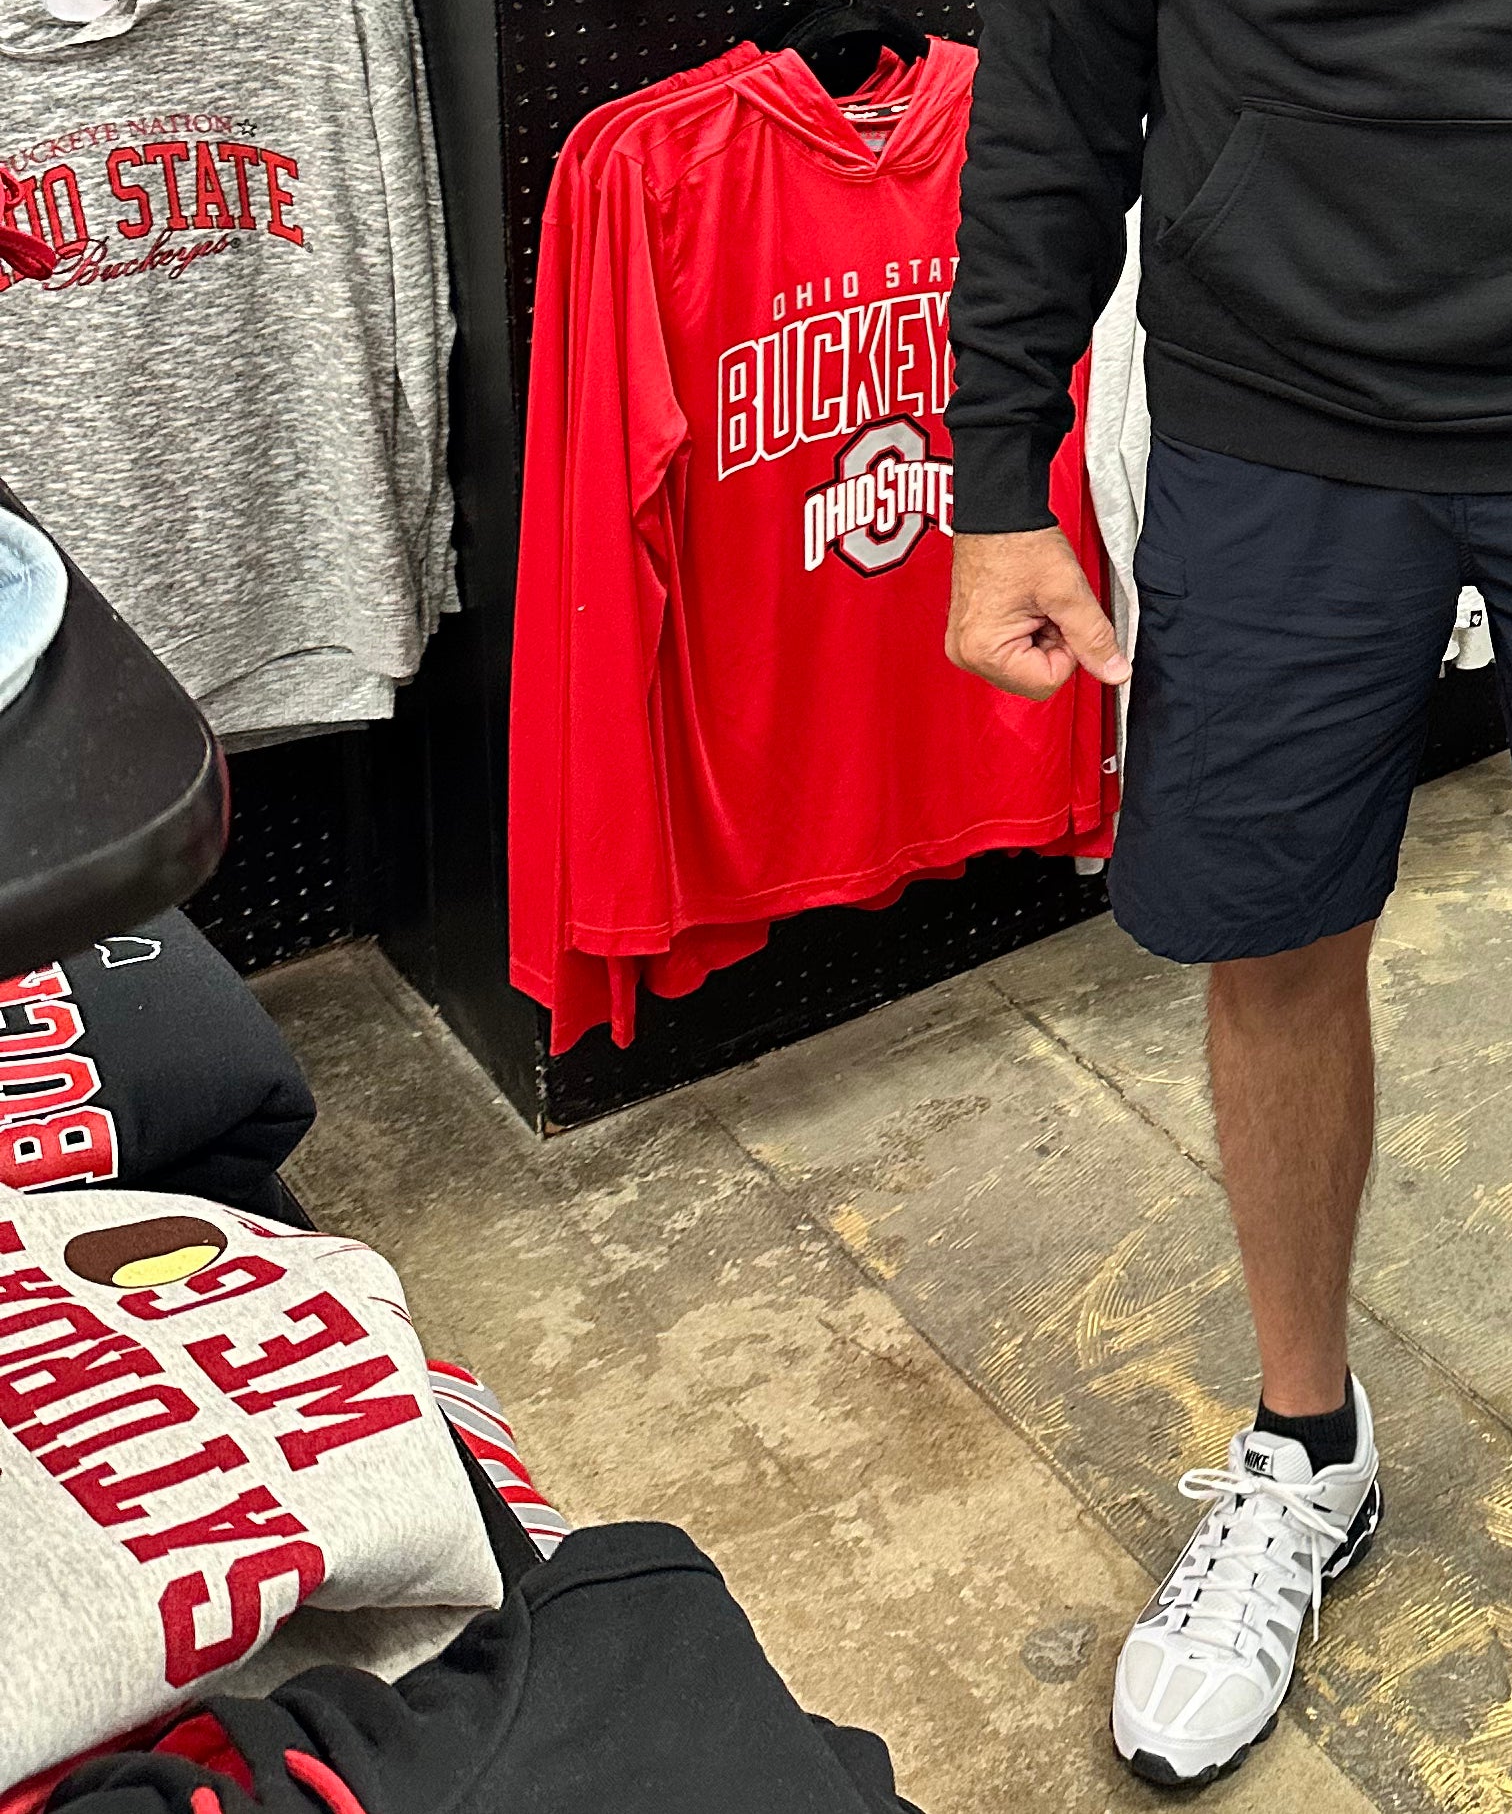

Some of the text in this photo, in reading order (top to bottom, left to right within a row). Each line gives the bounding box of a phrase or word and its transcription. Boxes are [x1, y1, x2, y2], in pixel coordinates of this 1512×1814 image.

[126, 114, 234, 137] NATION
[106, 141, 304, 248] STATE
[43, 227, 230, 291] Buckeyes
[772, 271, 860, 321] OHIO
[805, 472, 875, 572] OHIO
[0, 1220, 325, 1690] SATURDA
[1244, 1448, 1270, 1472] NIKE
